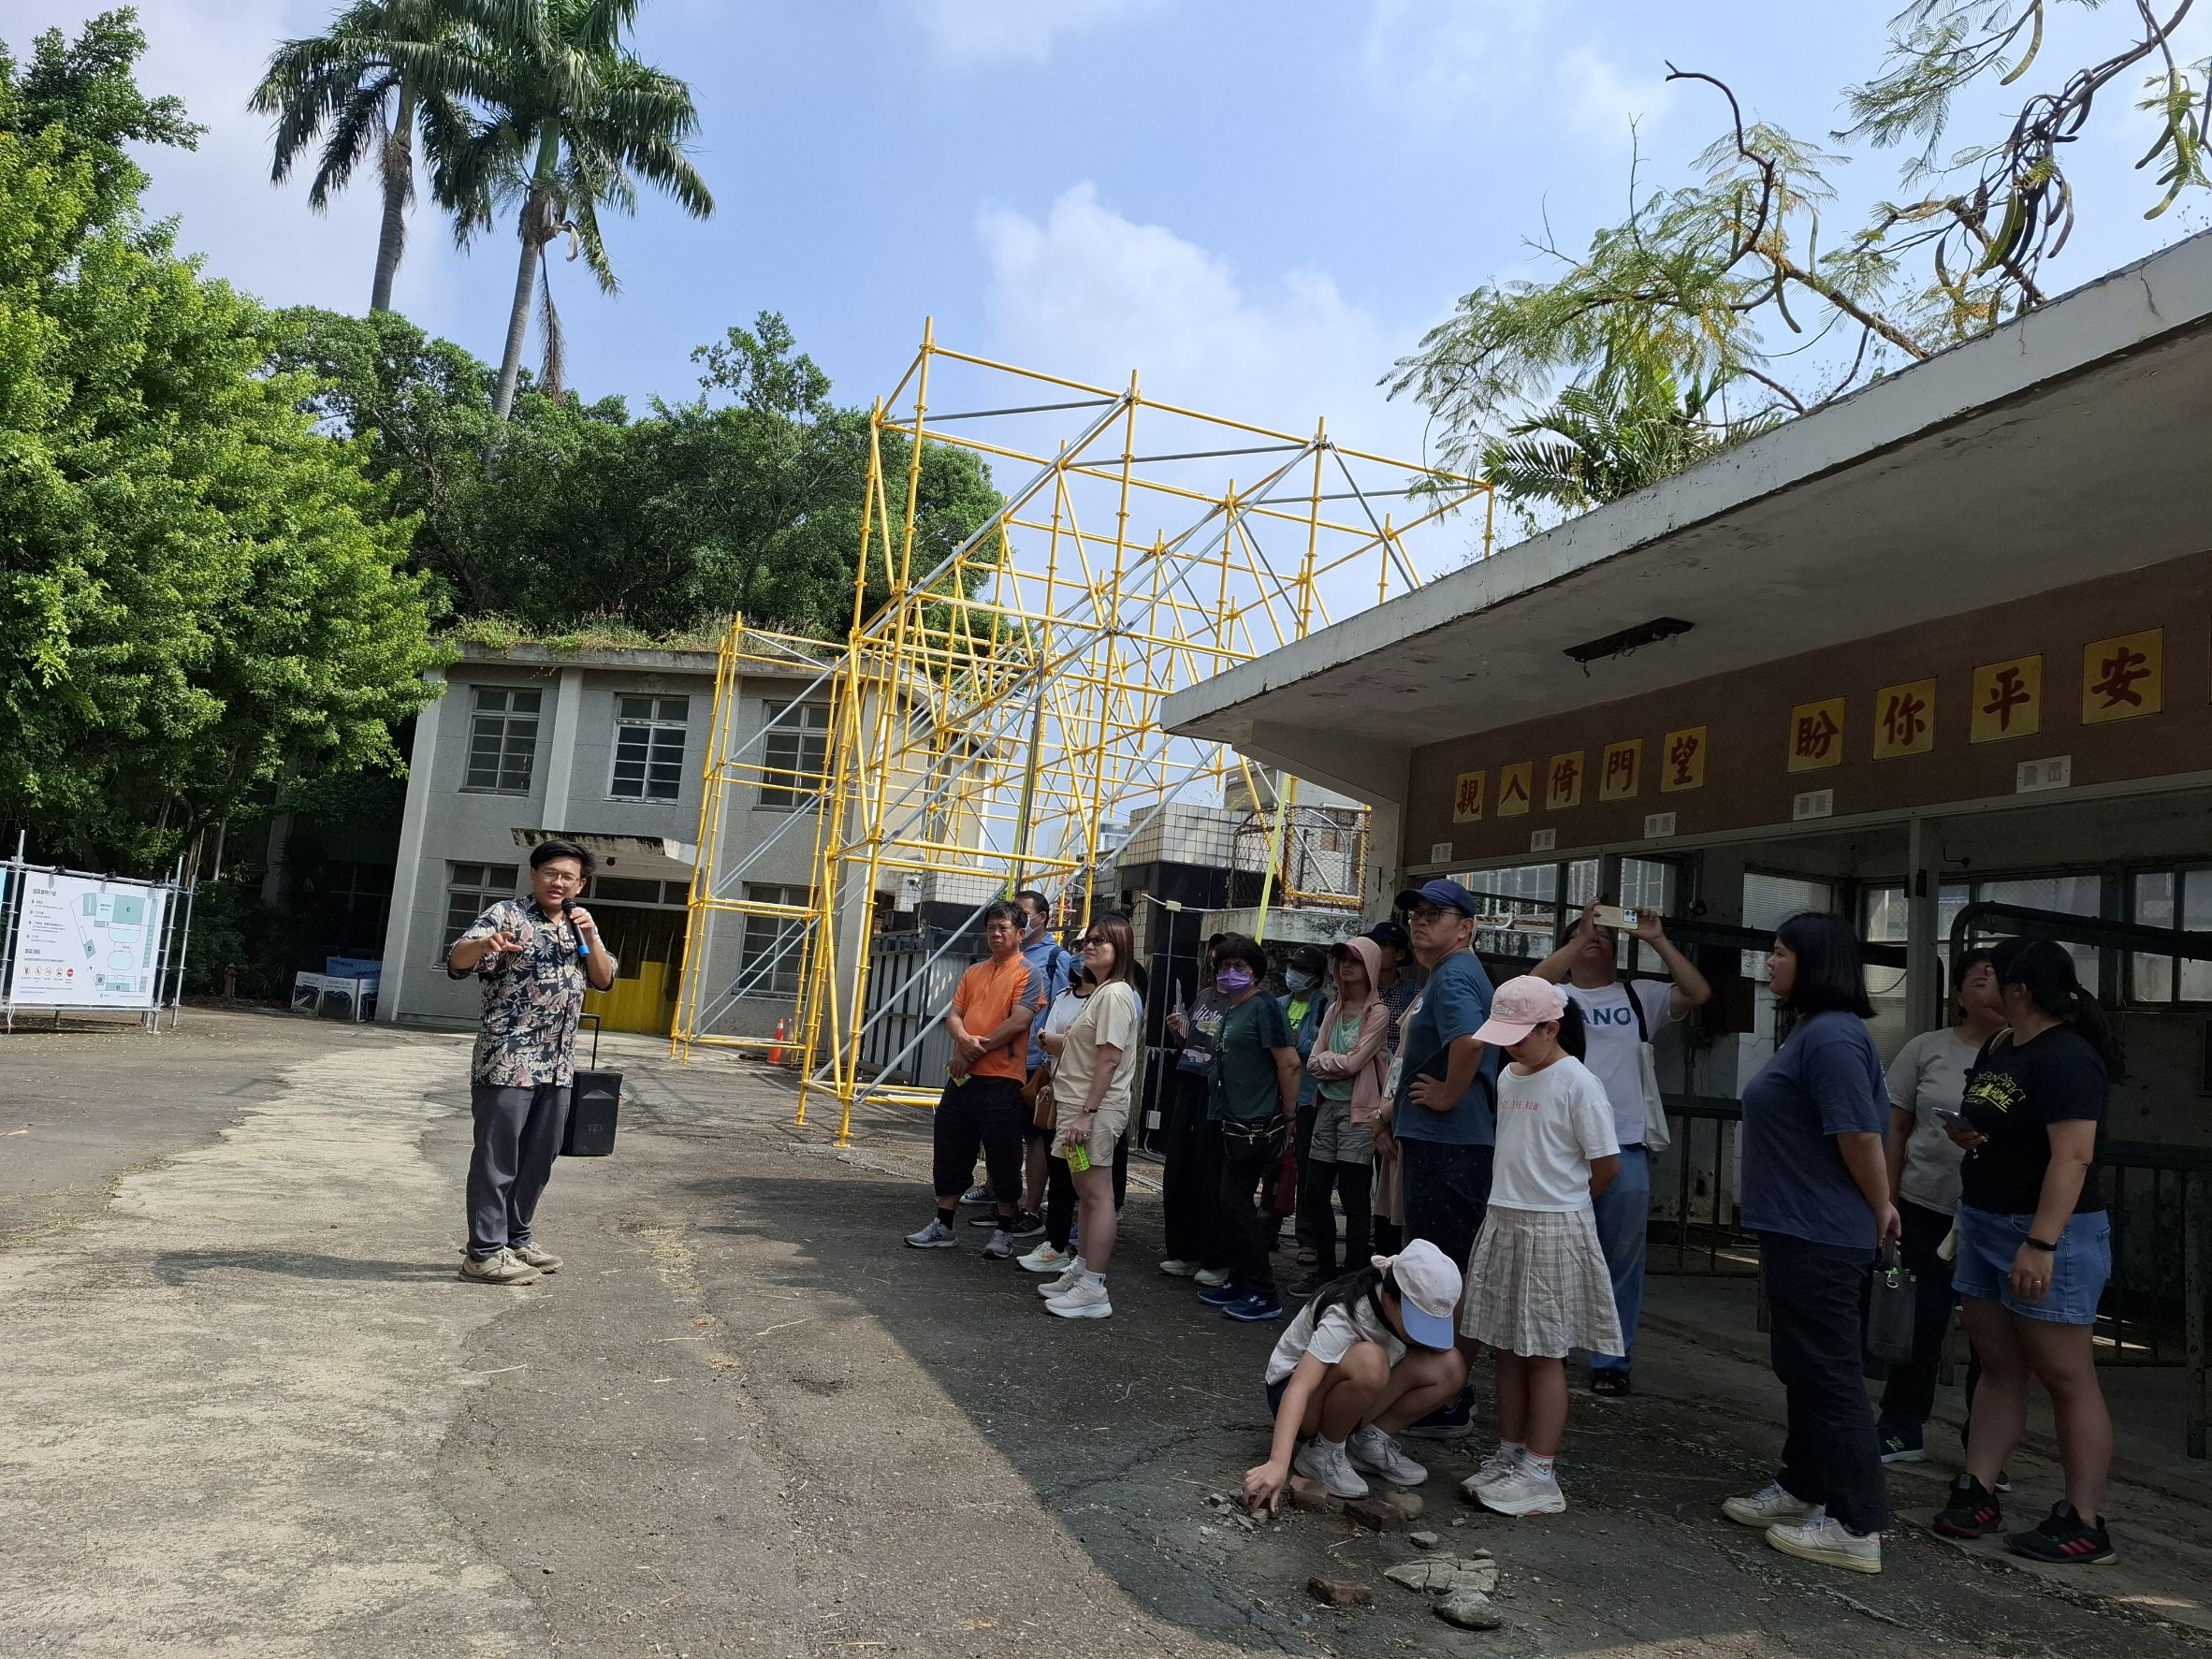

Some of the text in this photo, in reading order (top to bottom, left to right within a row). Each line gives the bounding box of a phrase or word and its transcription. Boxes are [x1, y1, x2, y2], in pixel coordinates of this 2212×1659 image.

[1456, 646, 2152, 816] 親人倚門望 盼你平安
